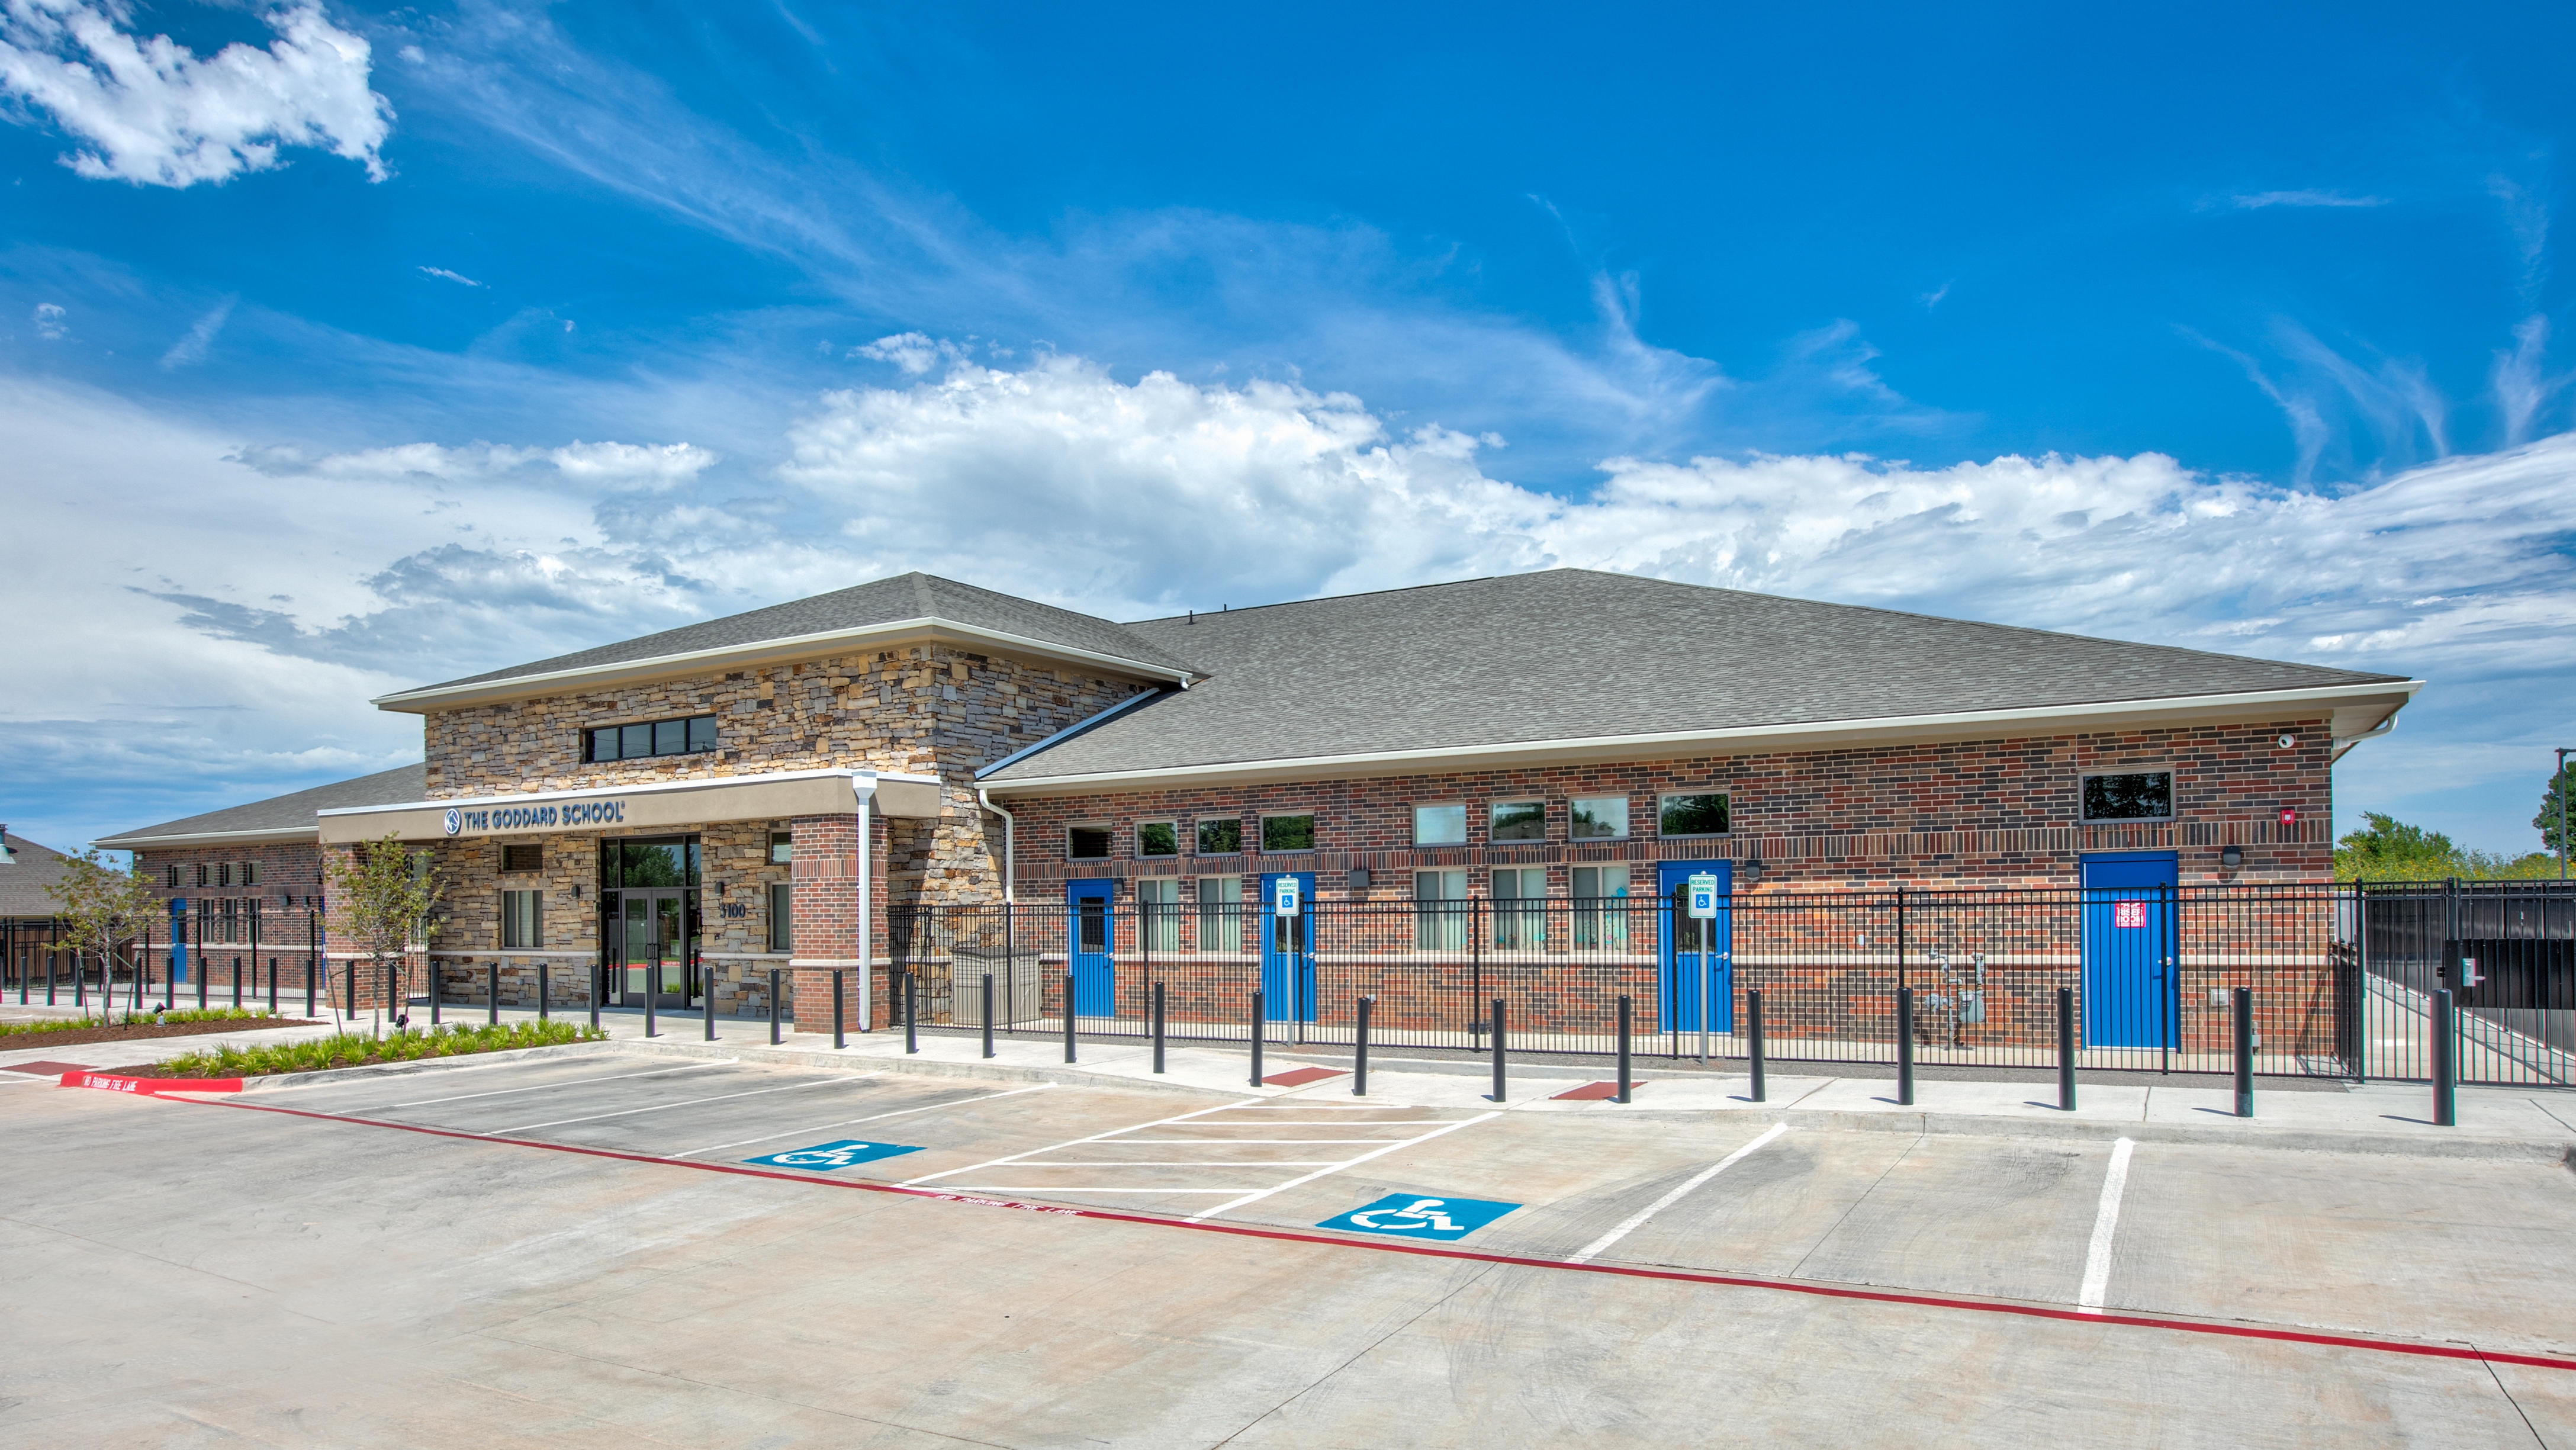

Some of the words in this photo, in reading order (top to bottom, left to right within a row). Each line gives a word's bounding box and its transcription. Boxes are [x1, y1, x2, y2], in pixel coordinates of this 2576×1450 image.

[464, 811, 488, 828] THE
[492, 806, 557, 827] GODDARD
[720, 904, 745, 918] 3100
[84, 1076, 91, 1086] NO
[91, 1077, 111, 1088] PARKING
[110, 1080, 123, 1090] FIRE
[122, 1081, 137, 1091] LANE
[959, 1197, 1008, 1207] PARKING
